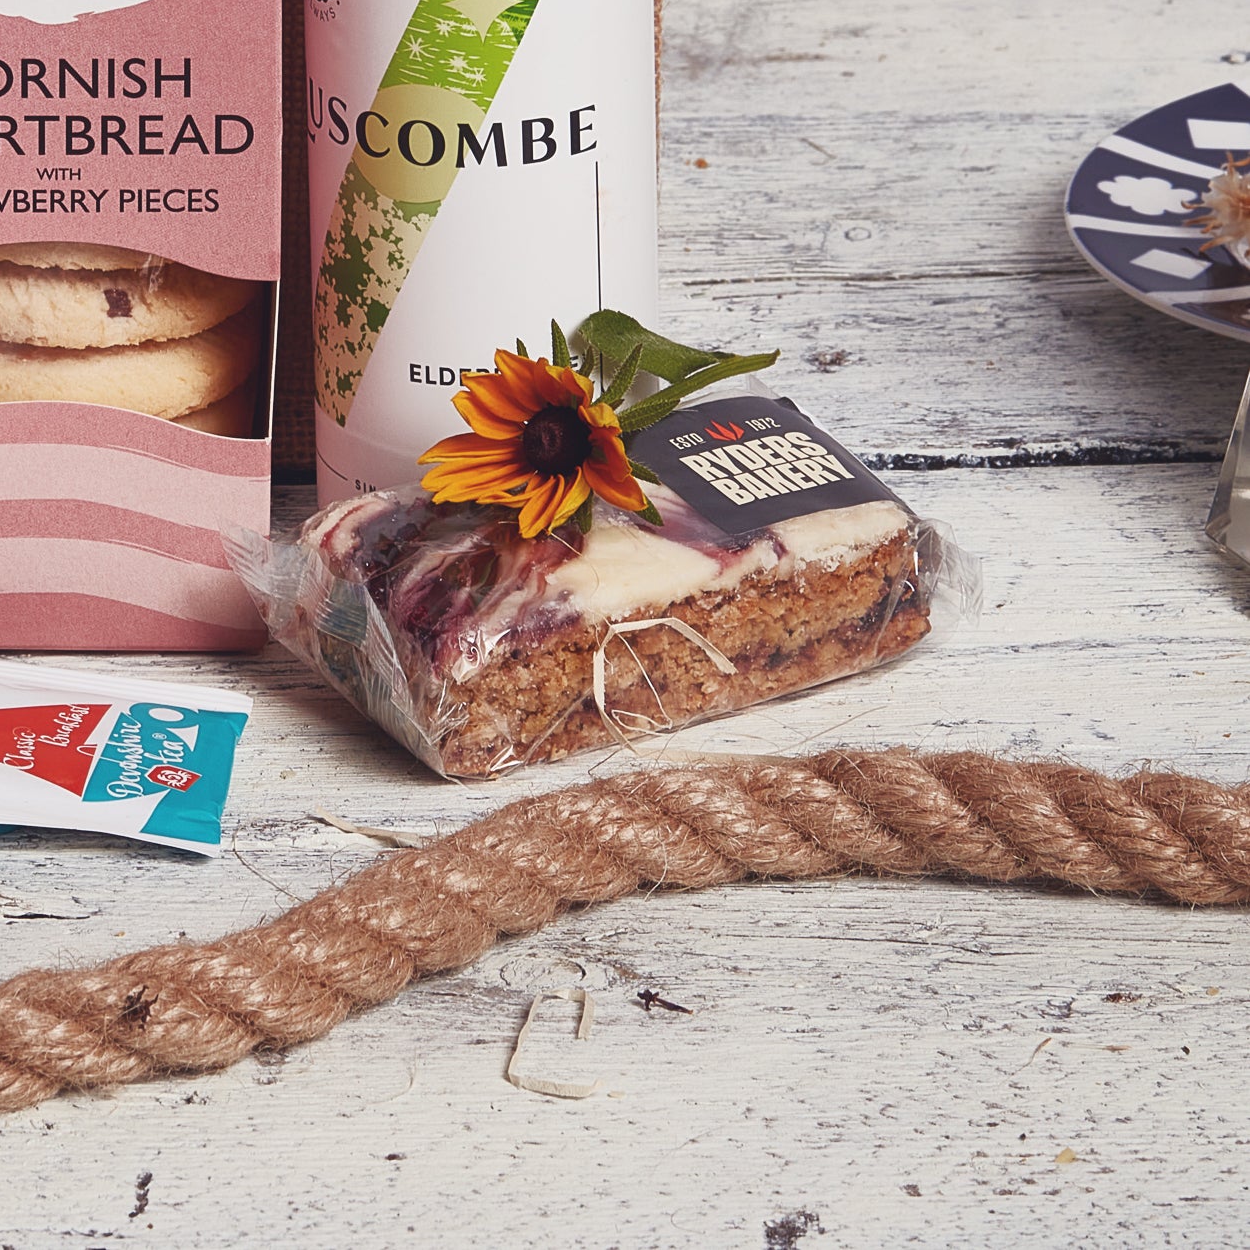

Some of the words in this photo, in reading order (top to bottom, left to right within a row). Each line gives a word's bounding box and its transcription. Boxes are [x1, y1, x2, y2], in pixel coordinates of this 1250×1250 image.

[36, 167, 82, 181] WITH
[119, 188, 220, 213] PIECES
[679, 431, 828, 482] RYDERS
[709, 454, 856, 506] BAKERY
[105, 716, 147, 799] Devonshire
